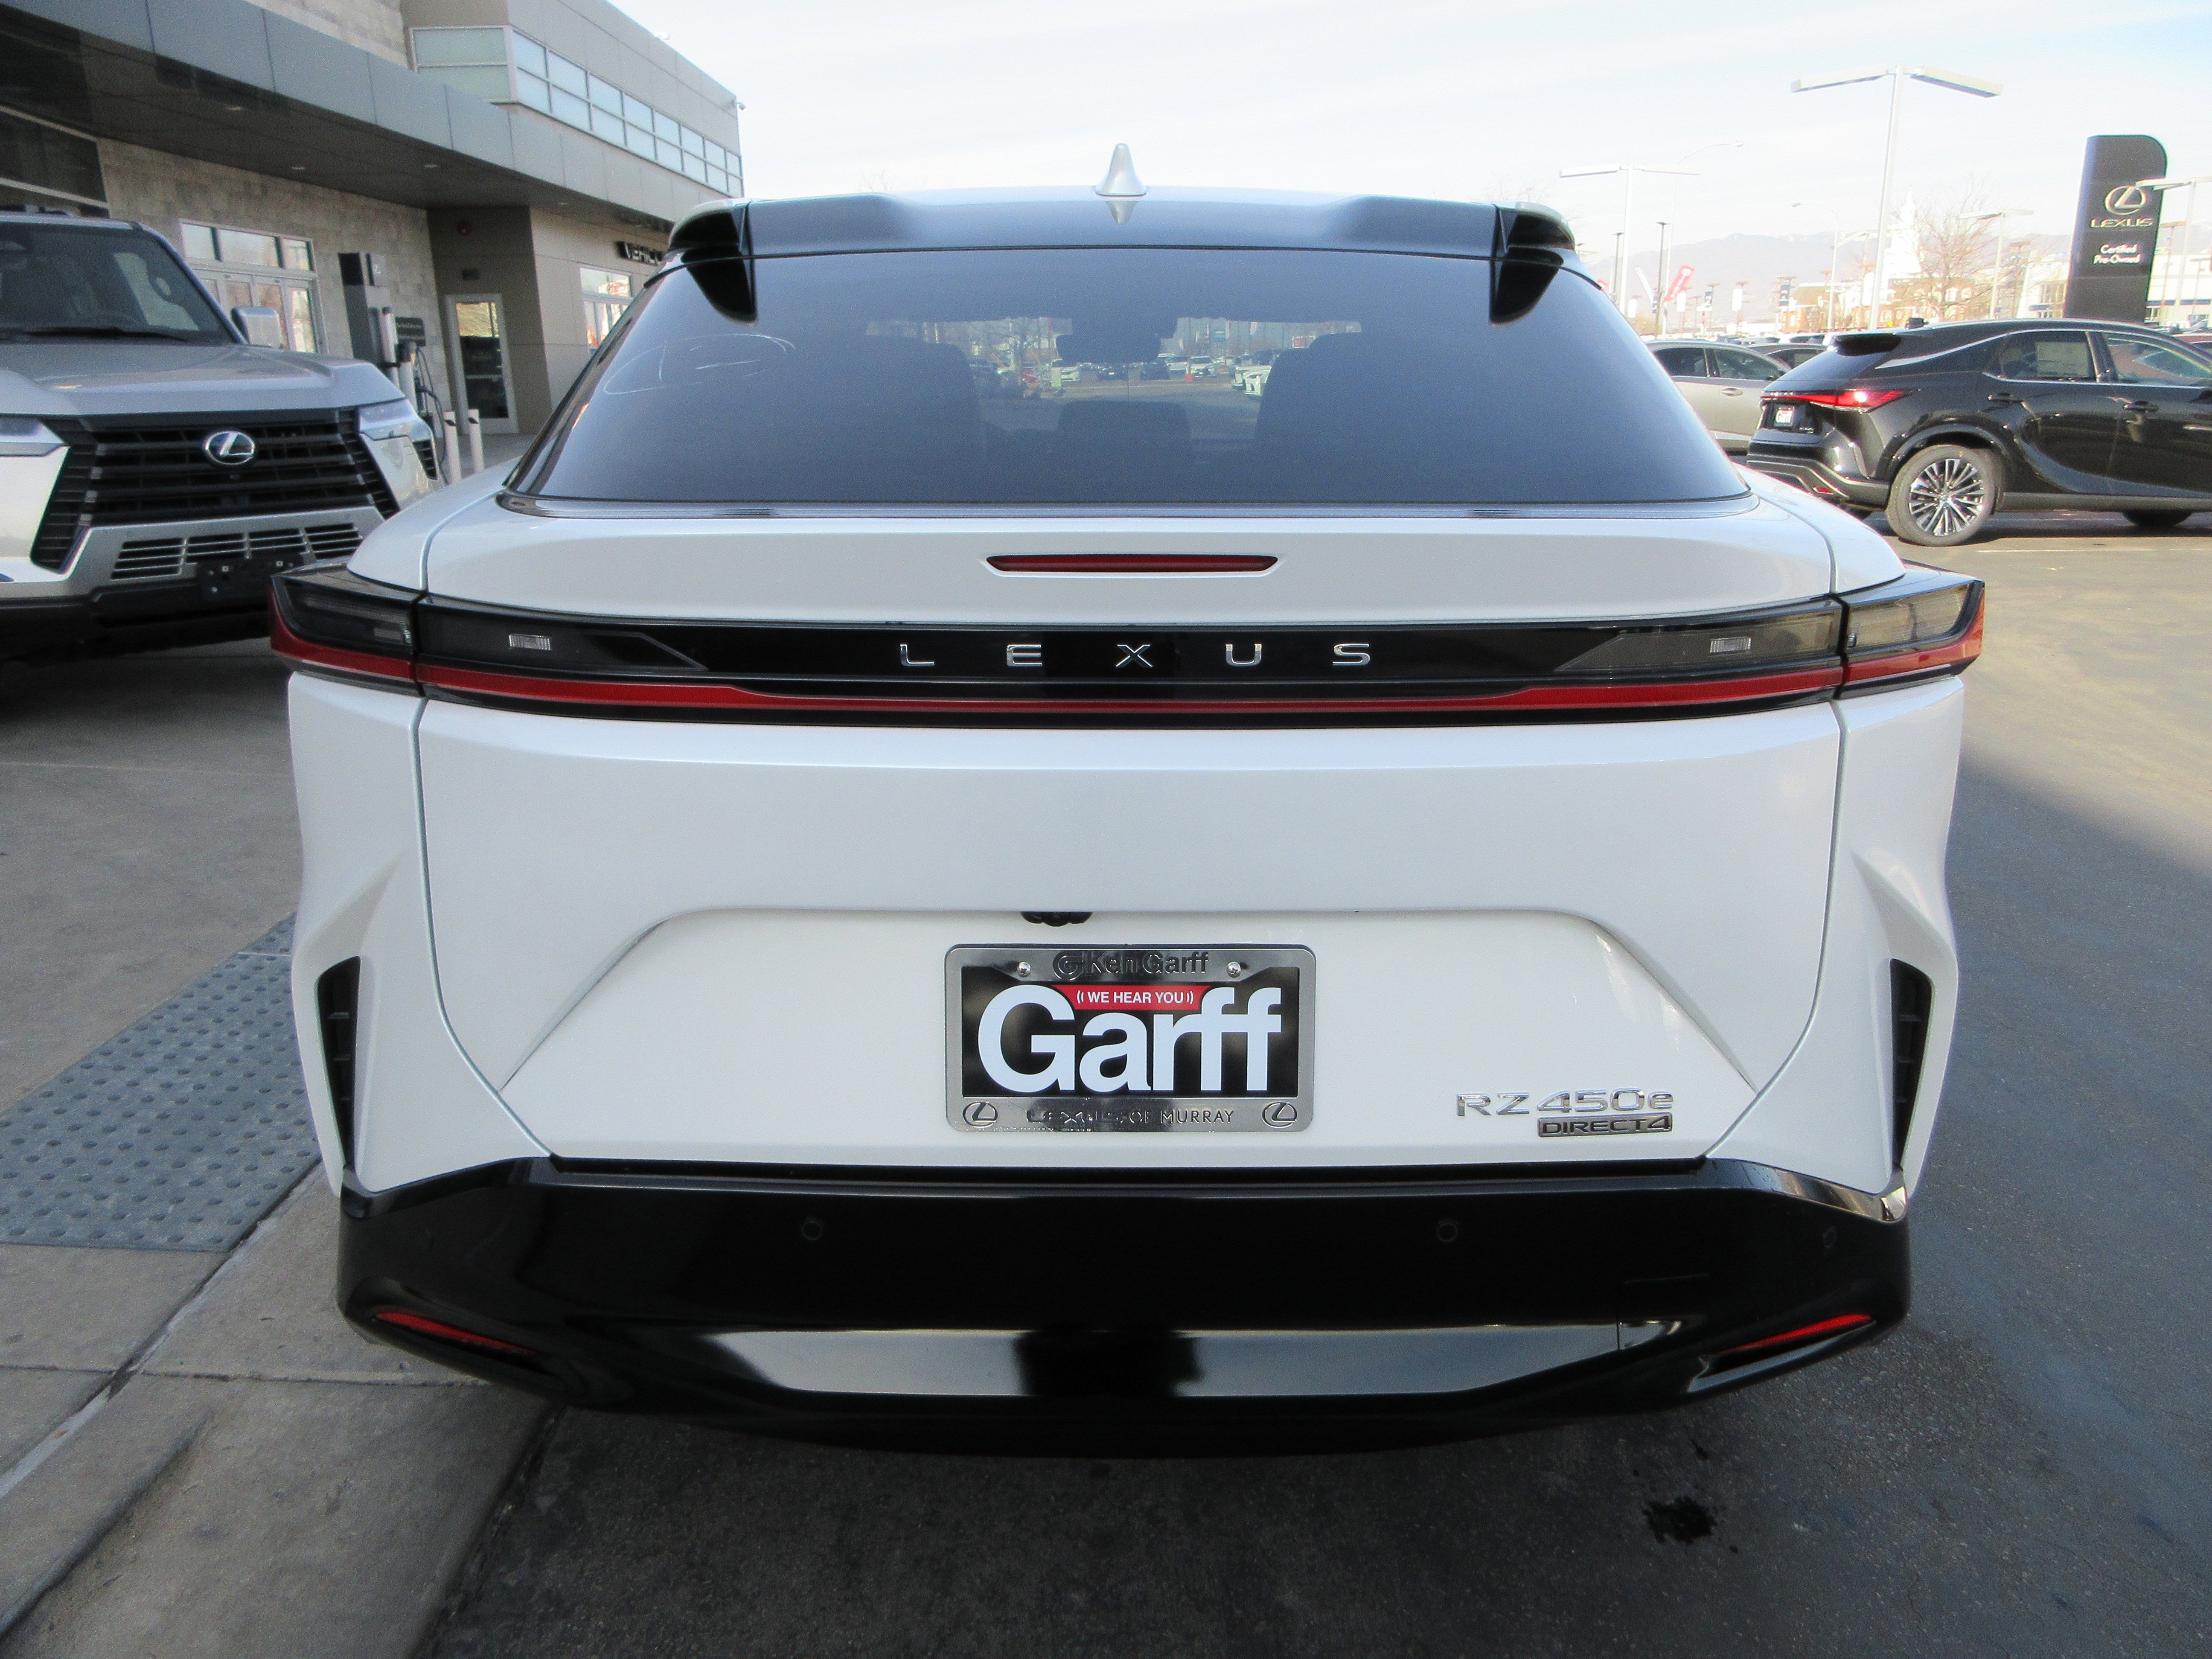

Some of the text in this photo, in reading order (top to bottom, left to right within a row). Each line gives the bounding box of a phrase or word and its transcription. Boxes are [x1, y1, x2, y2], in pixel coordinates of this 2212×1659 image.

[2090, 218, 2155, 228] LEXUS
[2100, 243, 2139, 254] Certified
[2093, 253, 2142, 264] Pre-Owned
[899, 643, 1371, 667] LEXUS
[1086, 950, 1209, 974] Ken Garff
[1087, 991, 1184, 1003] WE HEAR YOU
[978, 984, 1282, 1093] Garff
[1456, 1087, 1674, 1116] RZ 450e
[1129, 1111, 1150, 1124] OF
[1160, 1109, 1235, 1124] MURRAY
[1542, 1116, 1671, 1134] DIRECT4
